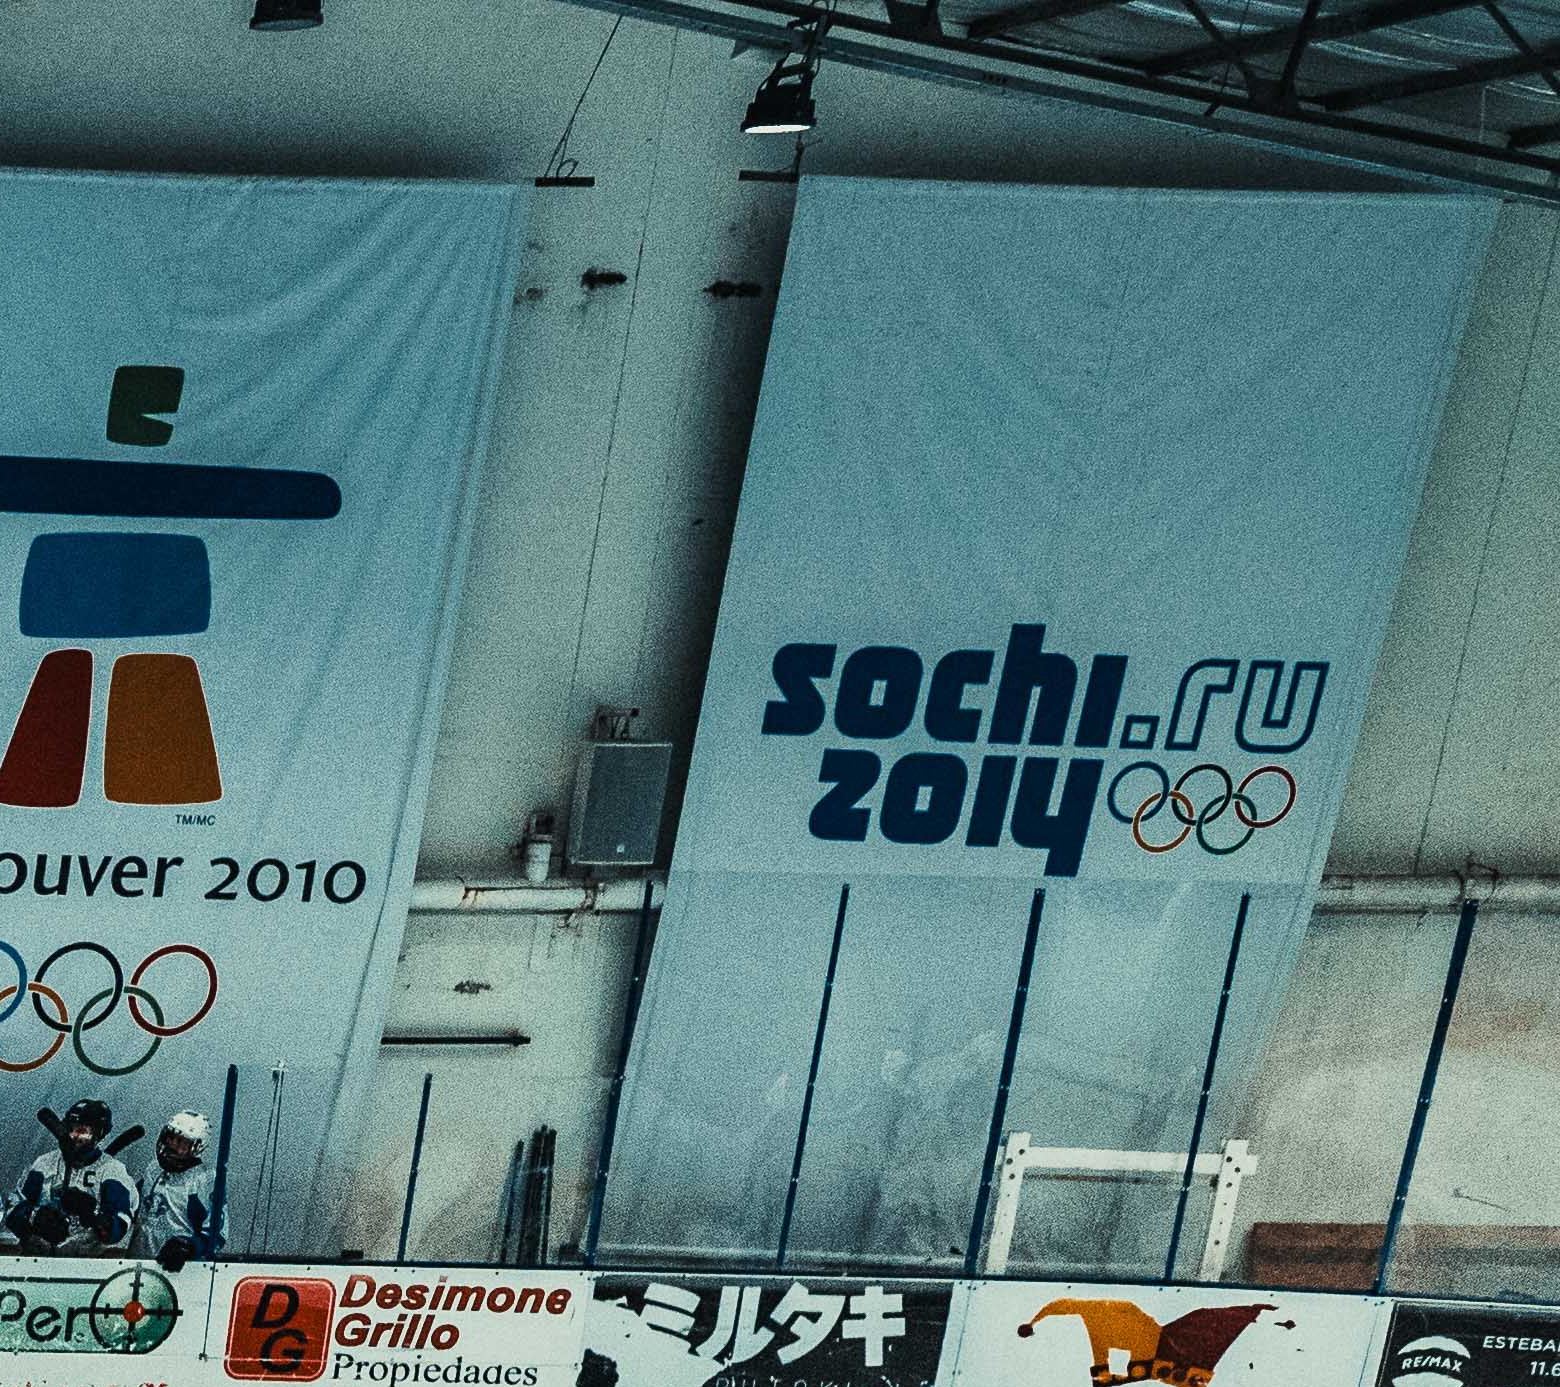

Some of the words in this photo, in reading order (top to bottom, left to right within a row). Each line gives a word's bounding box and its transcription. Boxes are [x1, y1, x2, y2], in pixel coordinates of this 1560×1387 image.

[175, 814, 216, 827] TM/MC
[809, 747, 1105, 877] 2014
[204, 857, 368, 905] 2010
[339, 1274, 573, 1315] Desimone
[334, 1312, 460, 1351] Grillo
[1400, 1355, 1463, 1373] RE/MAX
